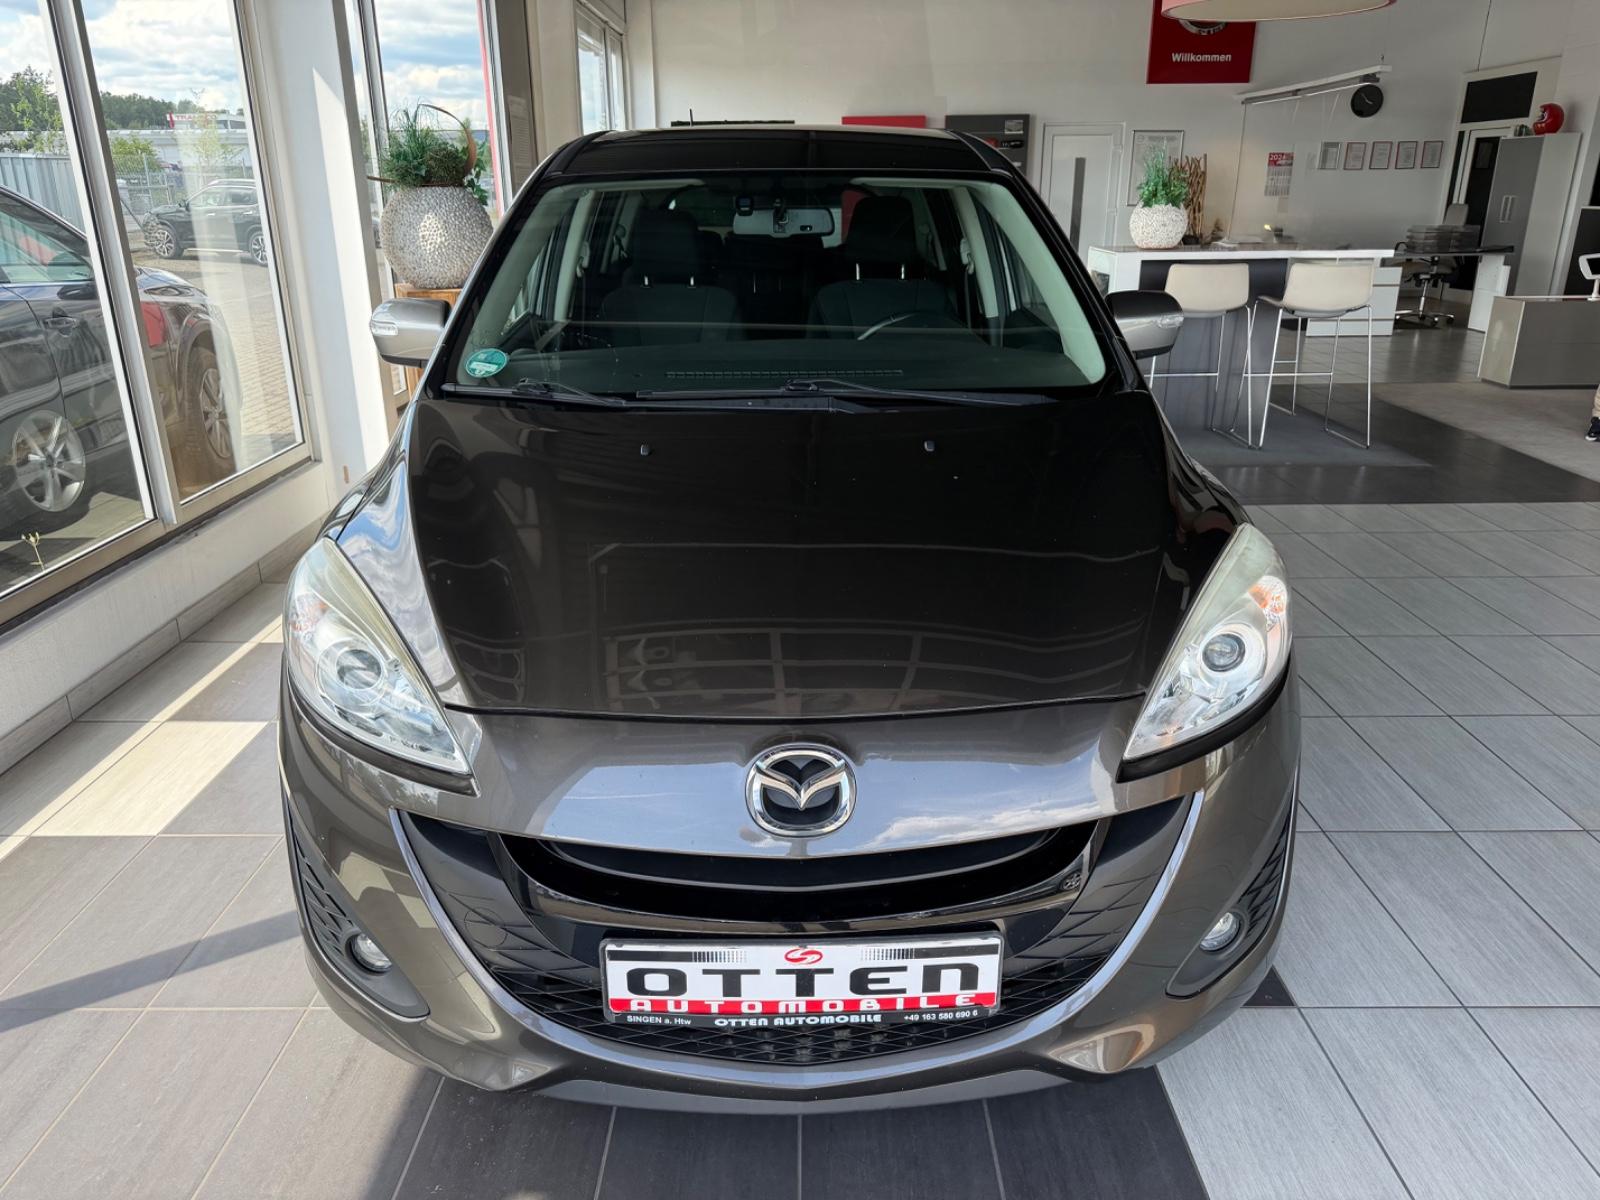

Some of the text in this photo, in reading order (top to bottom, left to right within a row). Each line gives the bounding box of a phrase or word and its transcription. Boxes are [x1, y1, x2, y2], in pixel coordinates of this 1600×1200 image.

[1171, 52, 1232, 62] Willkommen
[627, 963, 979, 997] OTTEN
[630, 994, 976, 1013] AUTOMOBILE
[955, 1010, 971, 1018] 690
[972, 1009, 978, 1017] 6
[626, 1015, 662, 1024] SINGEN
[715, 1014, 882, 1027] OTTEN AUTOMOBILE
